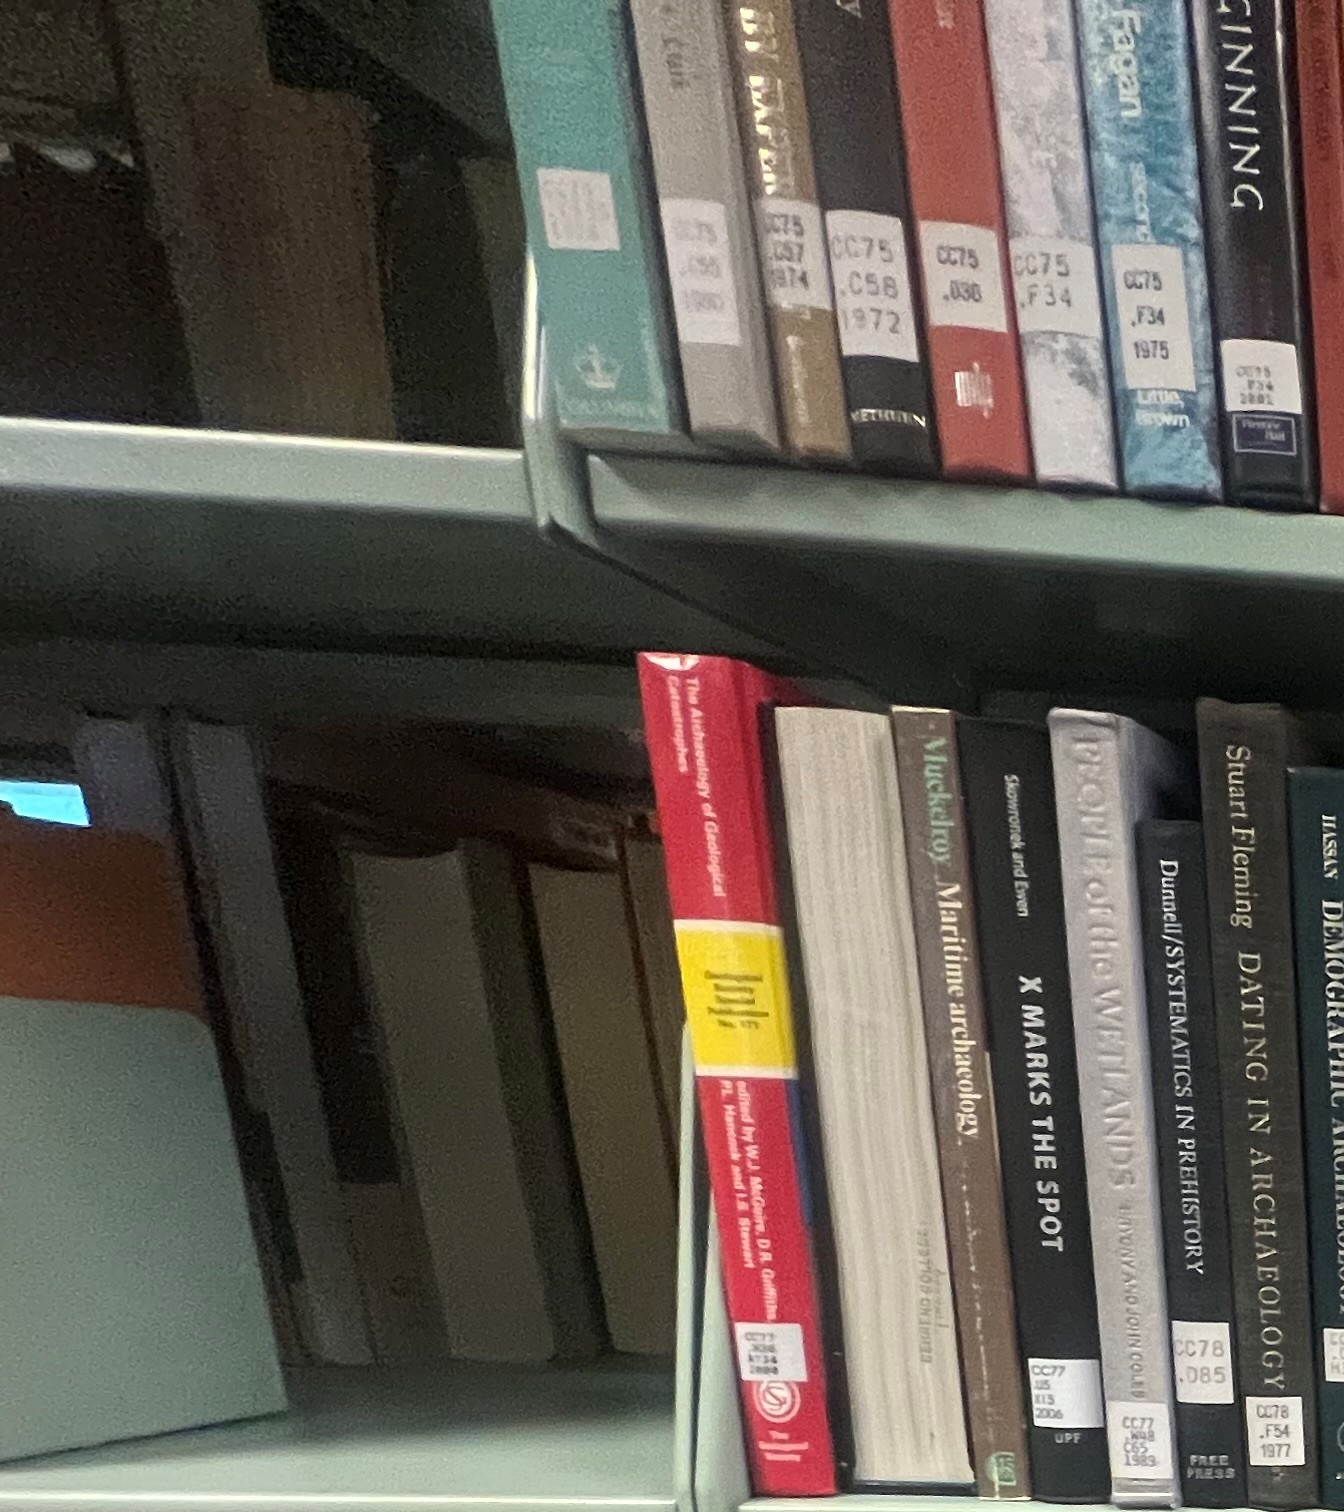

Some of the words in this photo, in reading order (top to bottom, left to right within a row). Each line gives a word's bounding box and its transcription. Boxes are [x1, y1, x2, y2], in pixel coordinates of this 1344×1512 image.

[922, 736, 954, 862] Muckelroy
[1224, 743, 1252, 820] Stuart
[1228, 825, 1259, 930] Fleming
[1320, 813, 1339, 880] HASSAN
[934, 879, 969, 996] Maritime
[1017, 973, 1043, 994] X
[1158, 857, 1193, 1098] Dunnell/SYSTEMATICS
[1020, 1002, 1052, 1107] MARKS
[1237, 950, 1269, 1082] DATING
[947, 998, 982, 1140] archaeology
[1173, 1103, 1196, 1131] IN
[1245, 1097, 1271, 1135] IN
[1030, 1114, 1058, 1171] THE
[1035, 1178, 1064, 1253] SPOT
[1176, 1136, 1204, 1275] PREHISTORY
[1248, 1146, 1285, 1392] ARCHAEOLOGY
